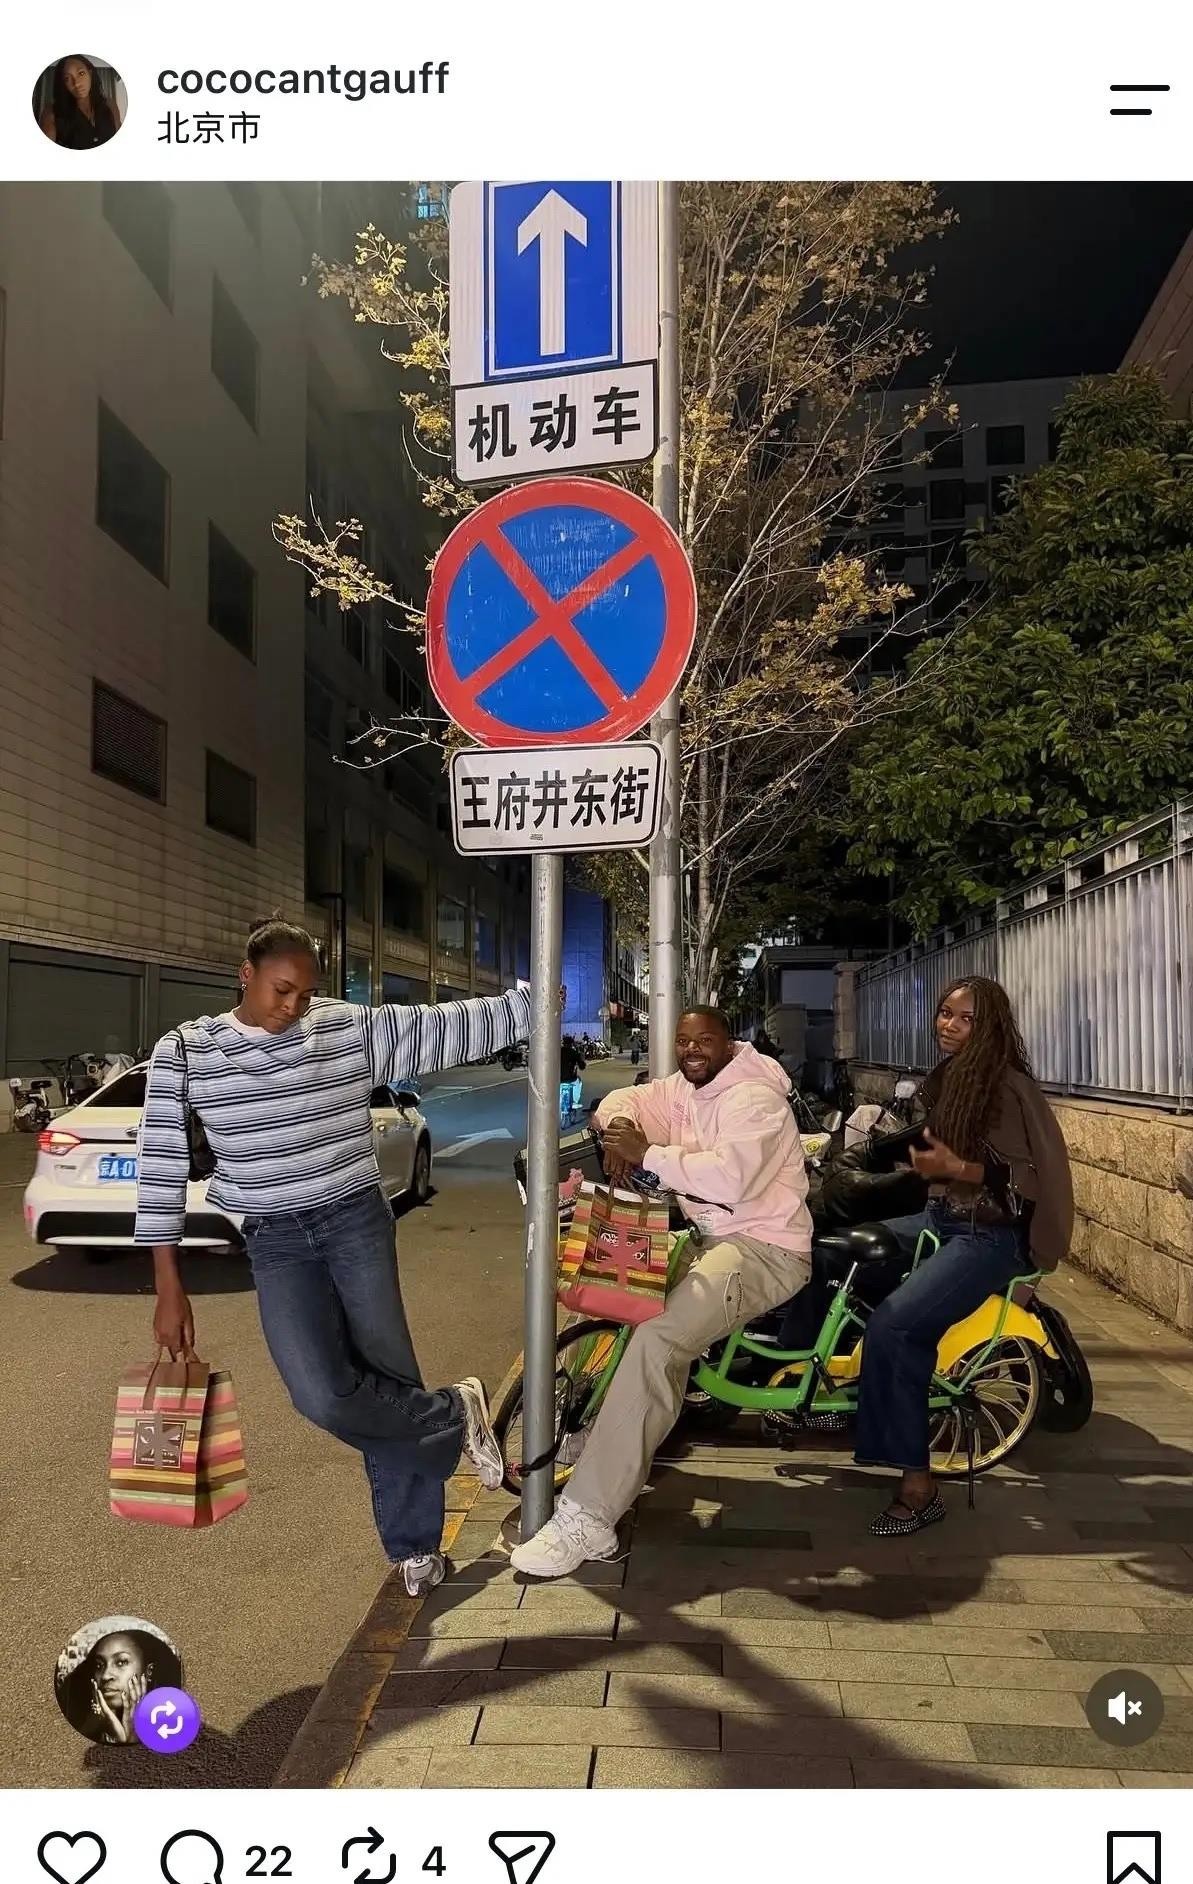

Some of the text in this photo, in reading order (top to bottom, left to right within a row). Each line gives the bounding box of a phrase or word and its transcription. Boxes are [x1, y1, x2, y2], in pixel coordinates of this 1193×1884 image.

[467, 386, 642, 463] 机动车
[461, 765, 650, 831] 王府井东街
